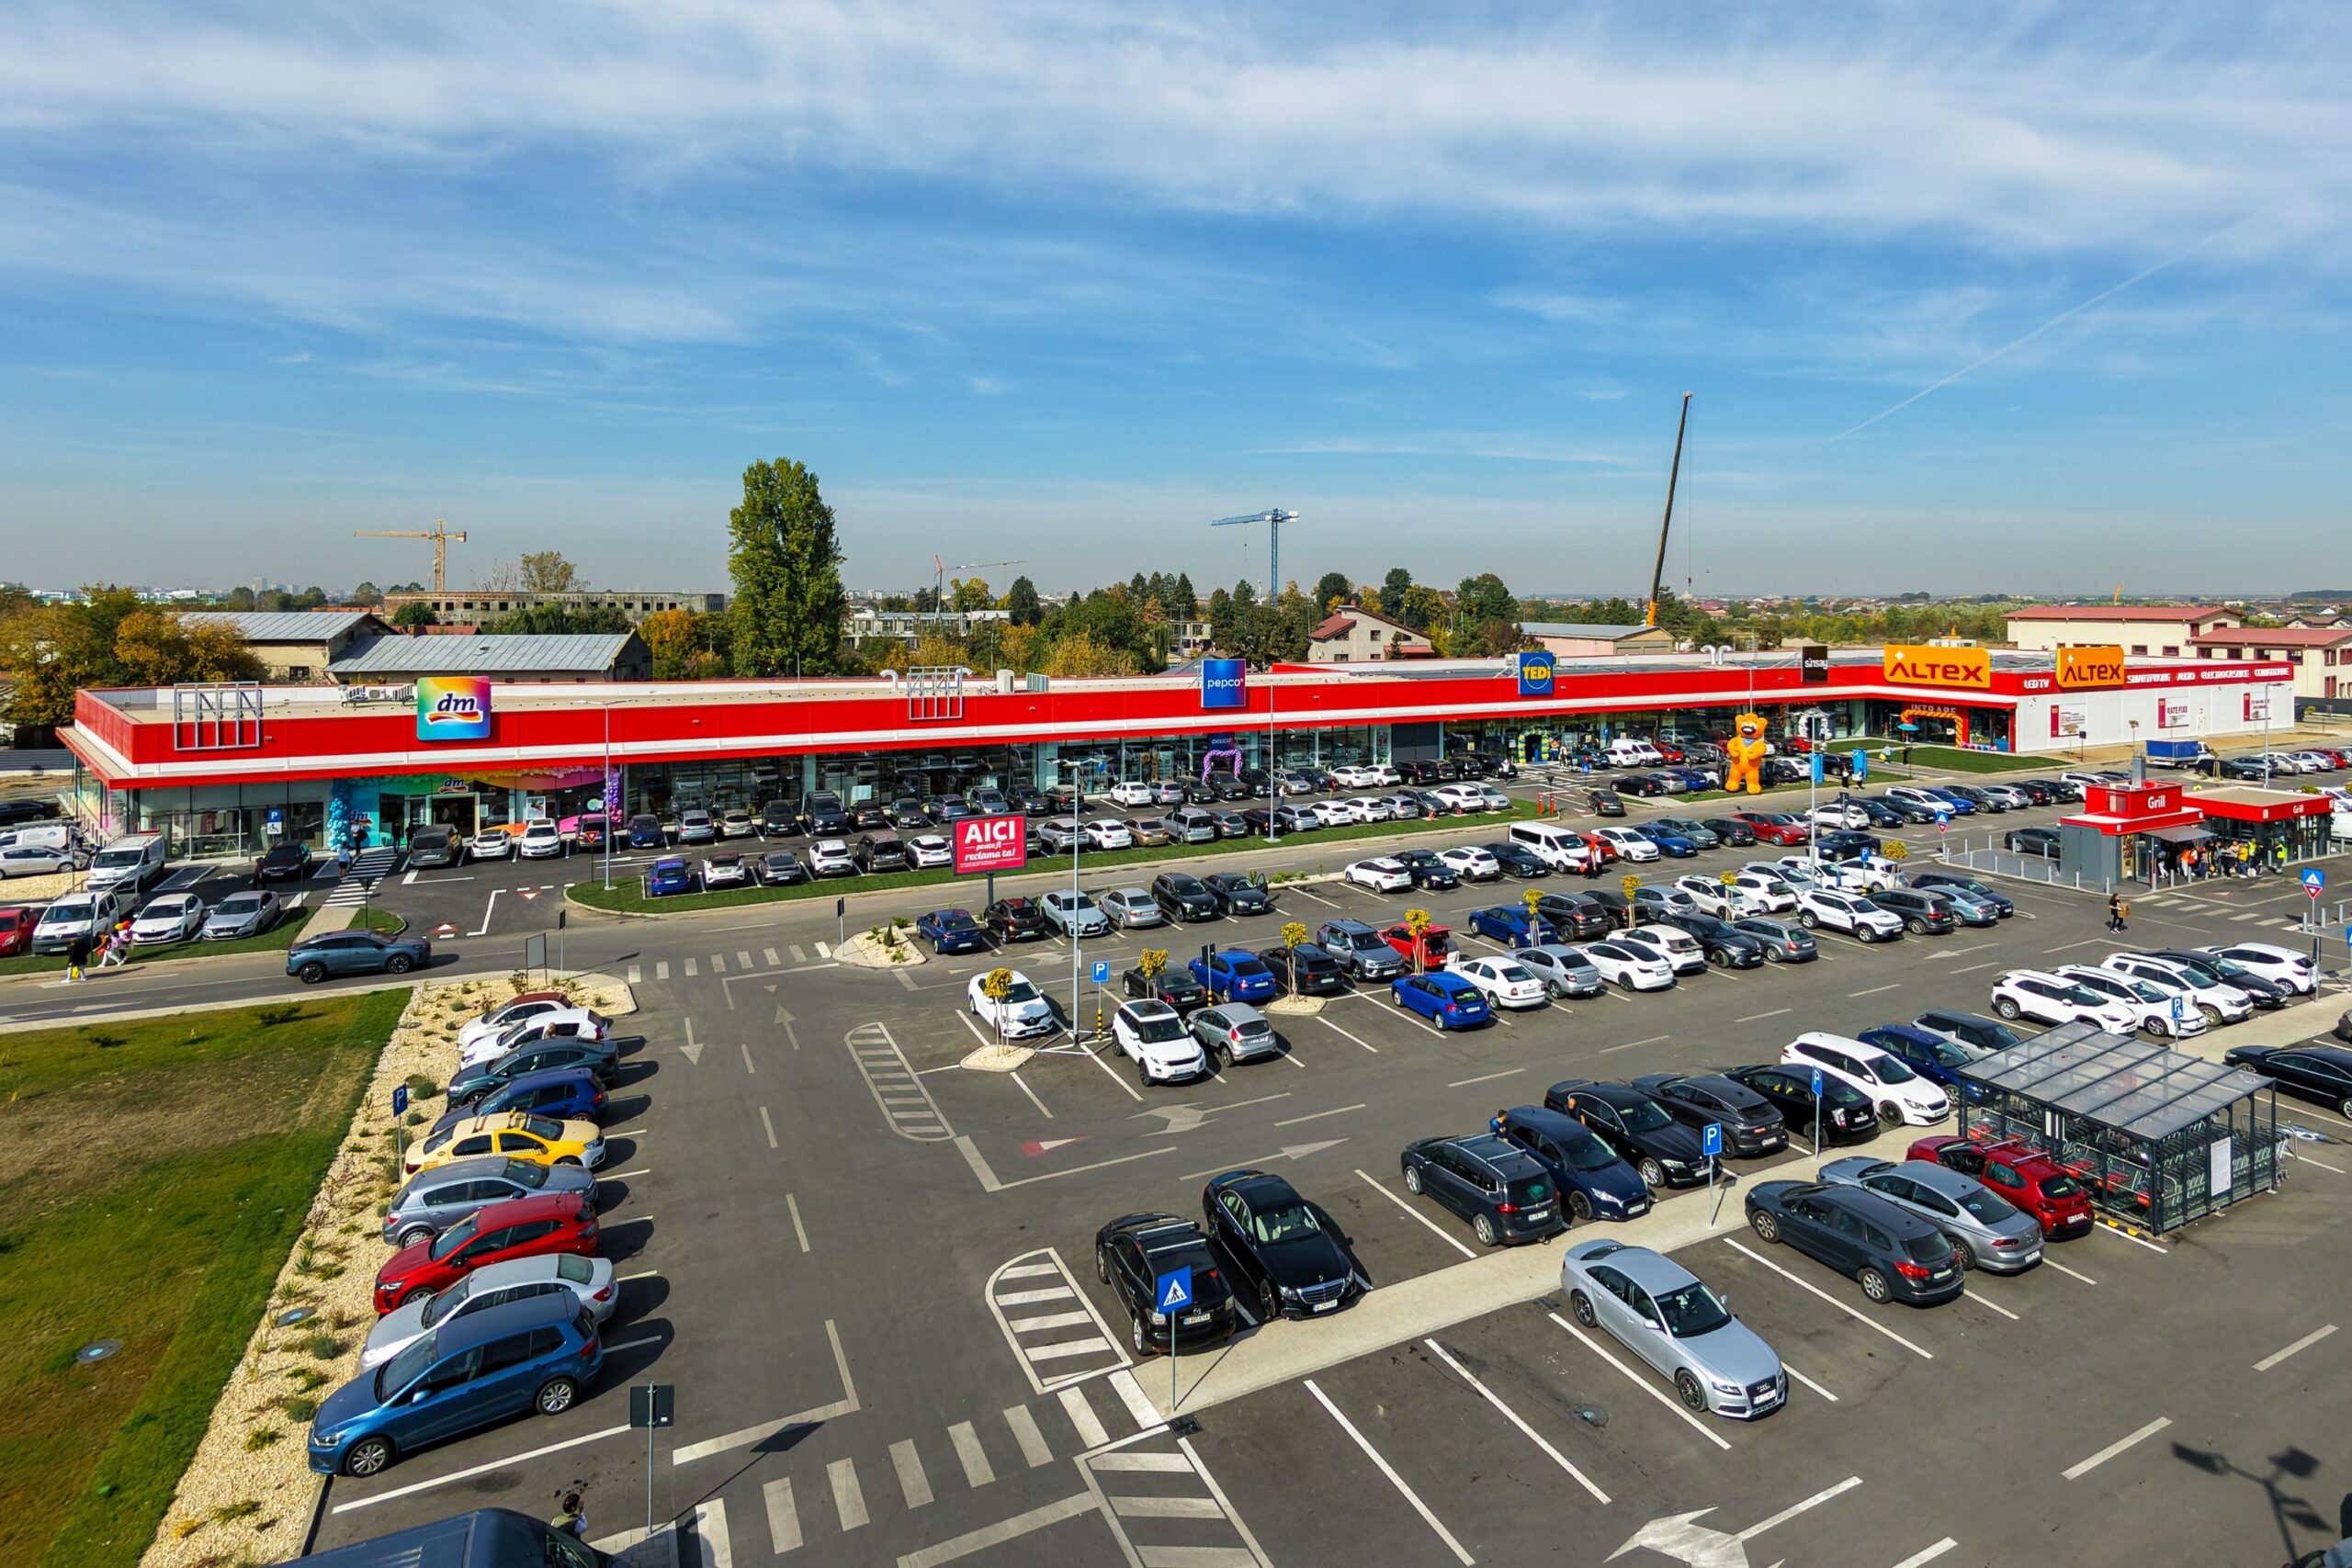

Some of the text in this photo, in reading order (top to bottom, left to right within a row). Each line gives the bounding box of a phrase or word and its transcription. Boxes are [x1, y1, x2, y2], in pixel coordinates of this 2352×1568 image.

[1804, 657, 1827, 670] sinsay
[1522, 666, 1551, 680] TEDi
[1207, 678, 1241, 690] pepco
[2023, 679, 2050, 689] LED TV
[437, 693, 476, 712] dm
[444, 778, 465, 787] dm
[2147, 795, 2166, 809] Grill
[2293, 805, 2304, 814] Grill
[965, 820, 1014, 843] AICI
[965, 848, 1015, 862] reclama ta!
[1096, 964, 1105, 976] P
[2175, 998, 2181, 1011] P
[1814, 1068, 1821, 1085] P
[397, 1089, 404, 1107] P
[1707, 1128, 1717, 1145] P
